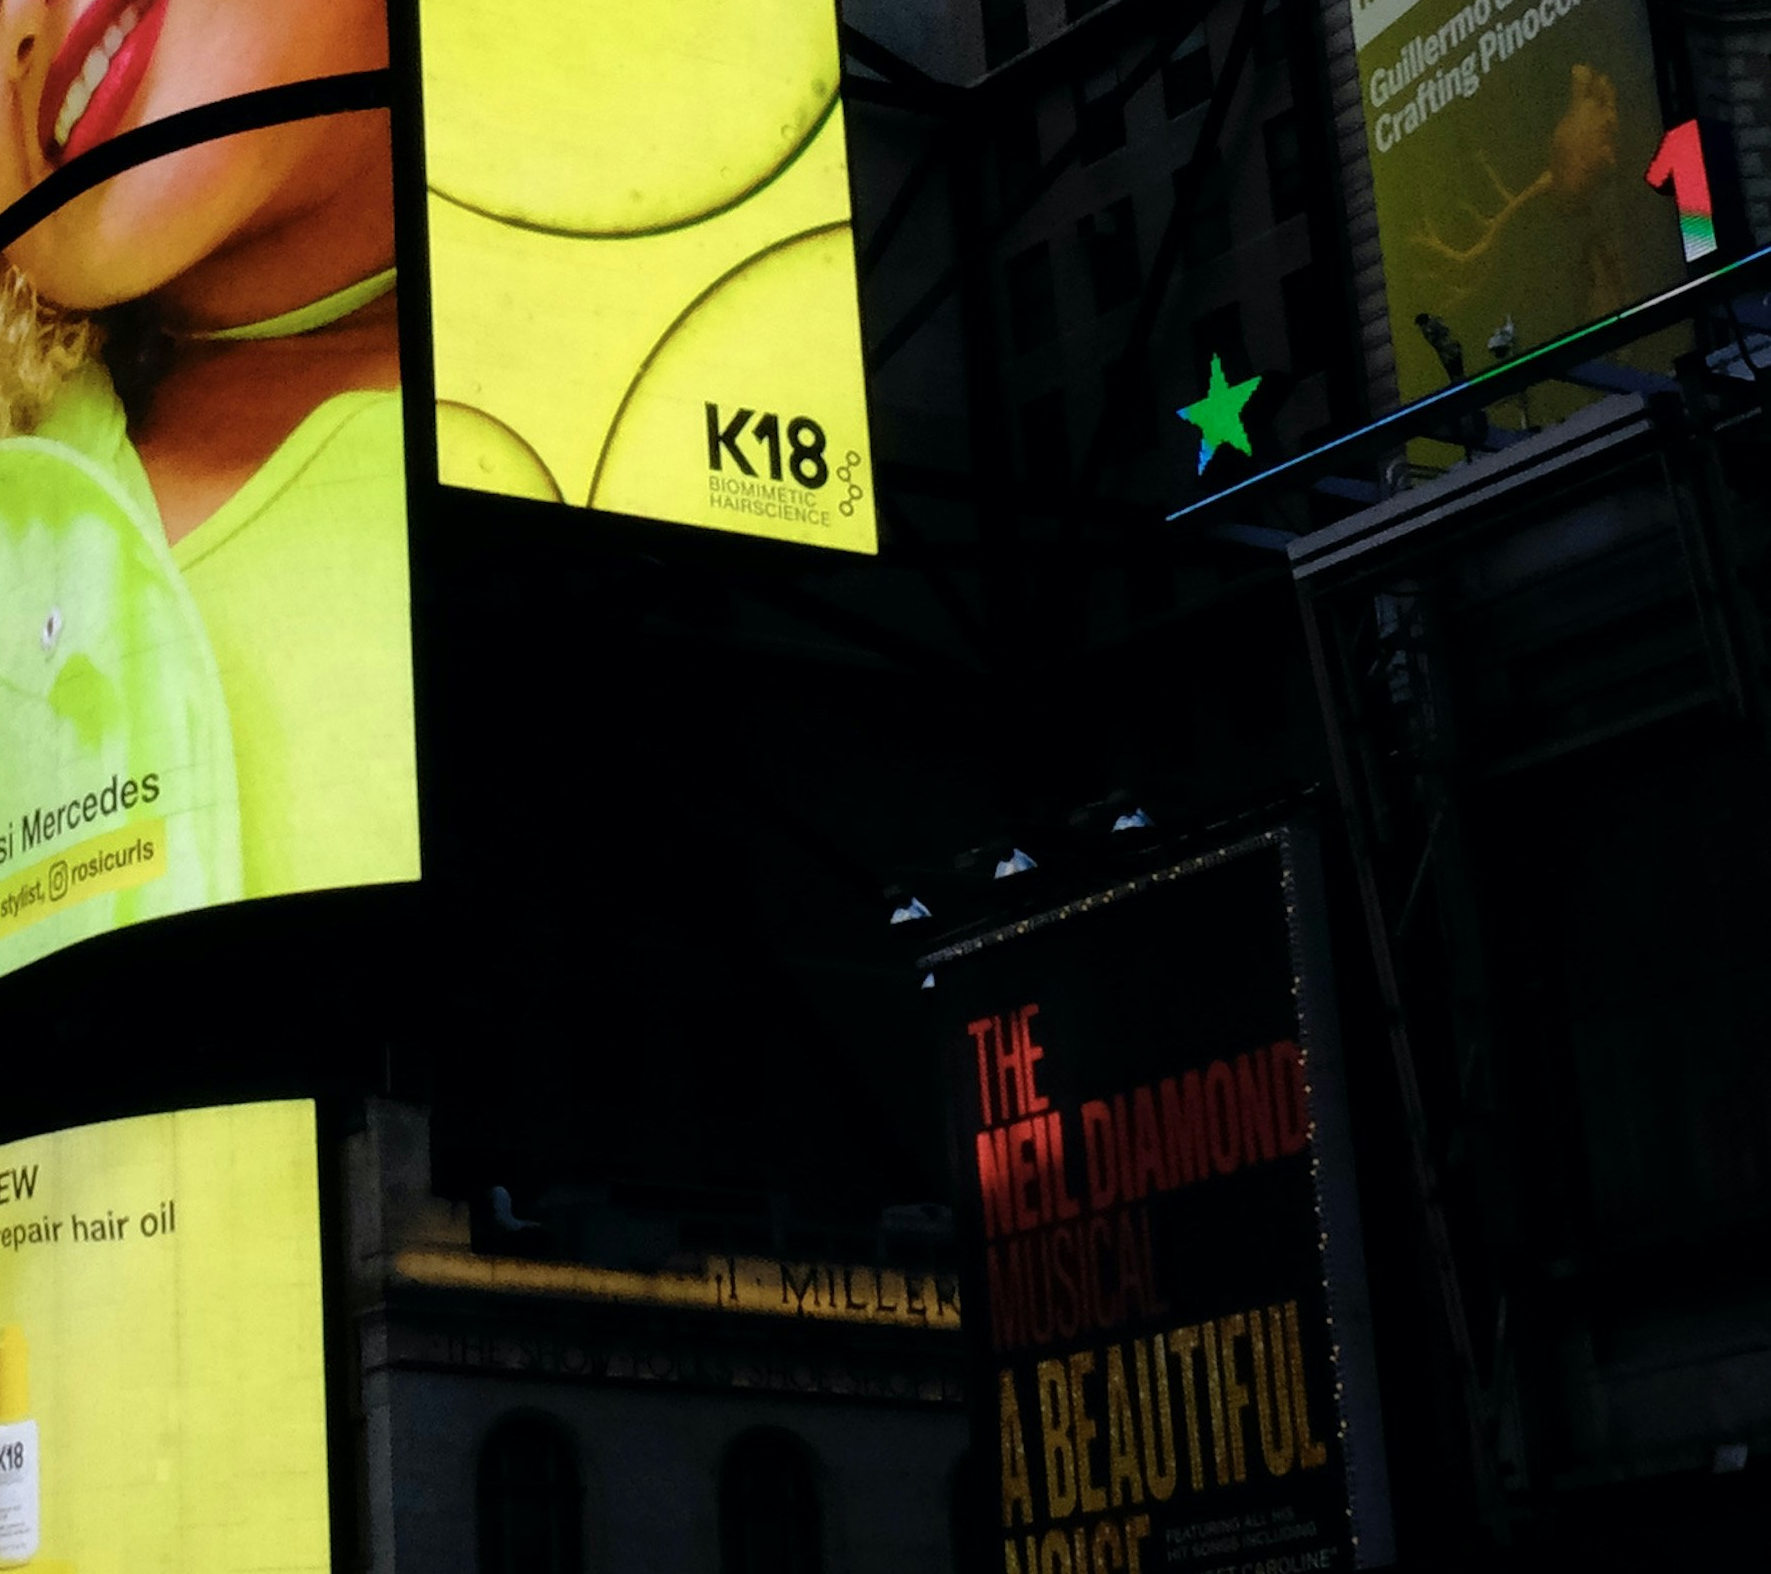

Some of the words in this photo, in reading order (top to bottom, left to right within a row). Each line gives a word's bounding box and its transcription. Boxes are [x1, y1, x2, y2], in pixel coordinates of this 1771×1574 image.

[1375, 52, 1479, 153] Crafting
[705, 400, 829, 489] K18
[709, 475, 817, 508] BIOMIMETIC
[710, 495, 831, 528] HAIRSCIENCE
[22, 773, 160, 853] Mercedes
[1, 880, 46, 918] stylist,
[71, 839, 155, 886] rosicurls
[967, 1002, 1051, 1127] THE
[975, 1110, 1080, 1239] NEIL
[1080, 1036, 1308, 1210] DIAMOND
[71, 1209, 130, 1243] hair
[139, 1199, 177, 1238] oil
[779, 1262, 963, 1317] MILLER
[985, 1202, 1172, 1350] MUSICAL
[997, 1366, 1035, 1529] A
[1035, 1299, 1329, 1520] BEAUTIFUL
[1166, 1544, 1190, 1562] HIT
[1244, 1512, 1268, 1528] ALL
